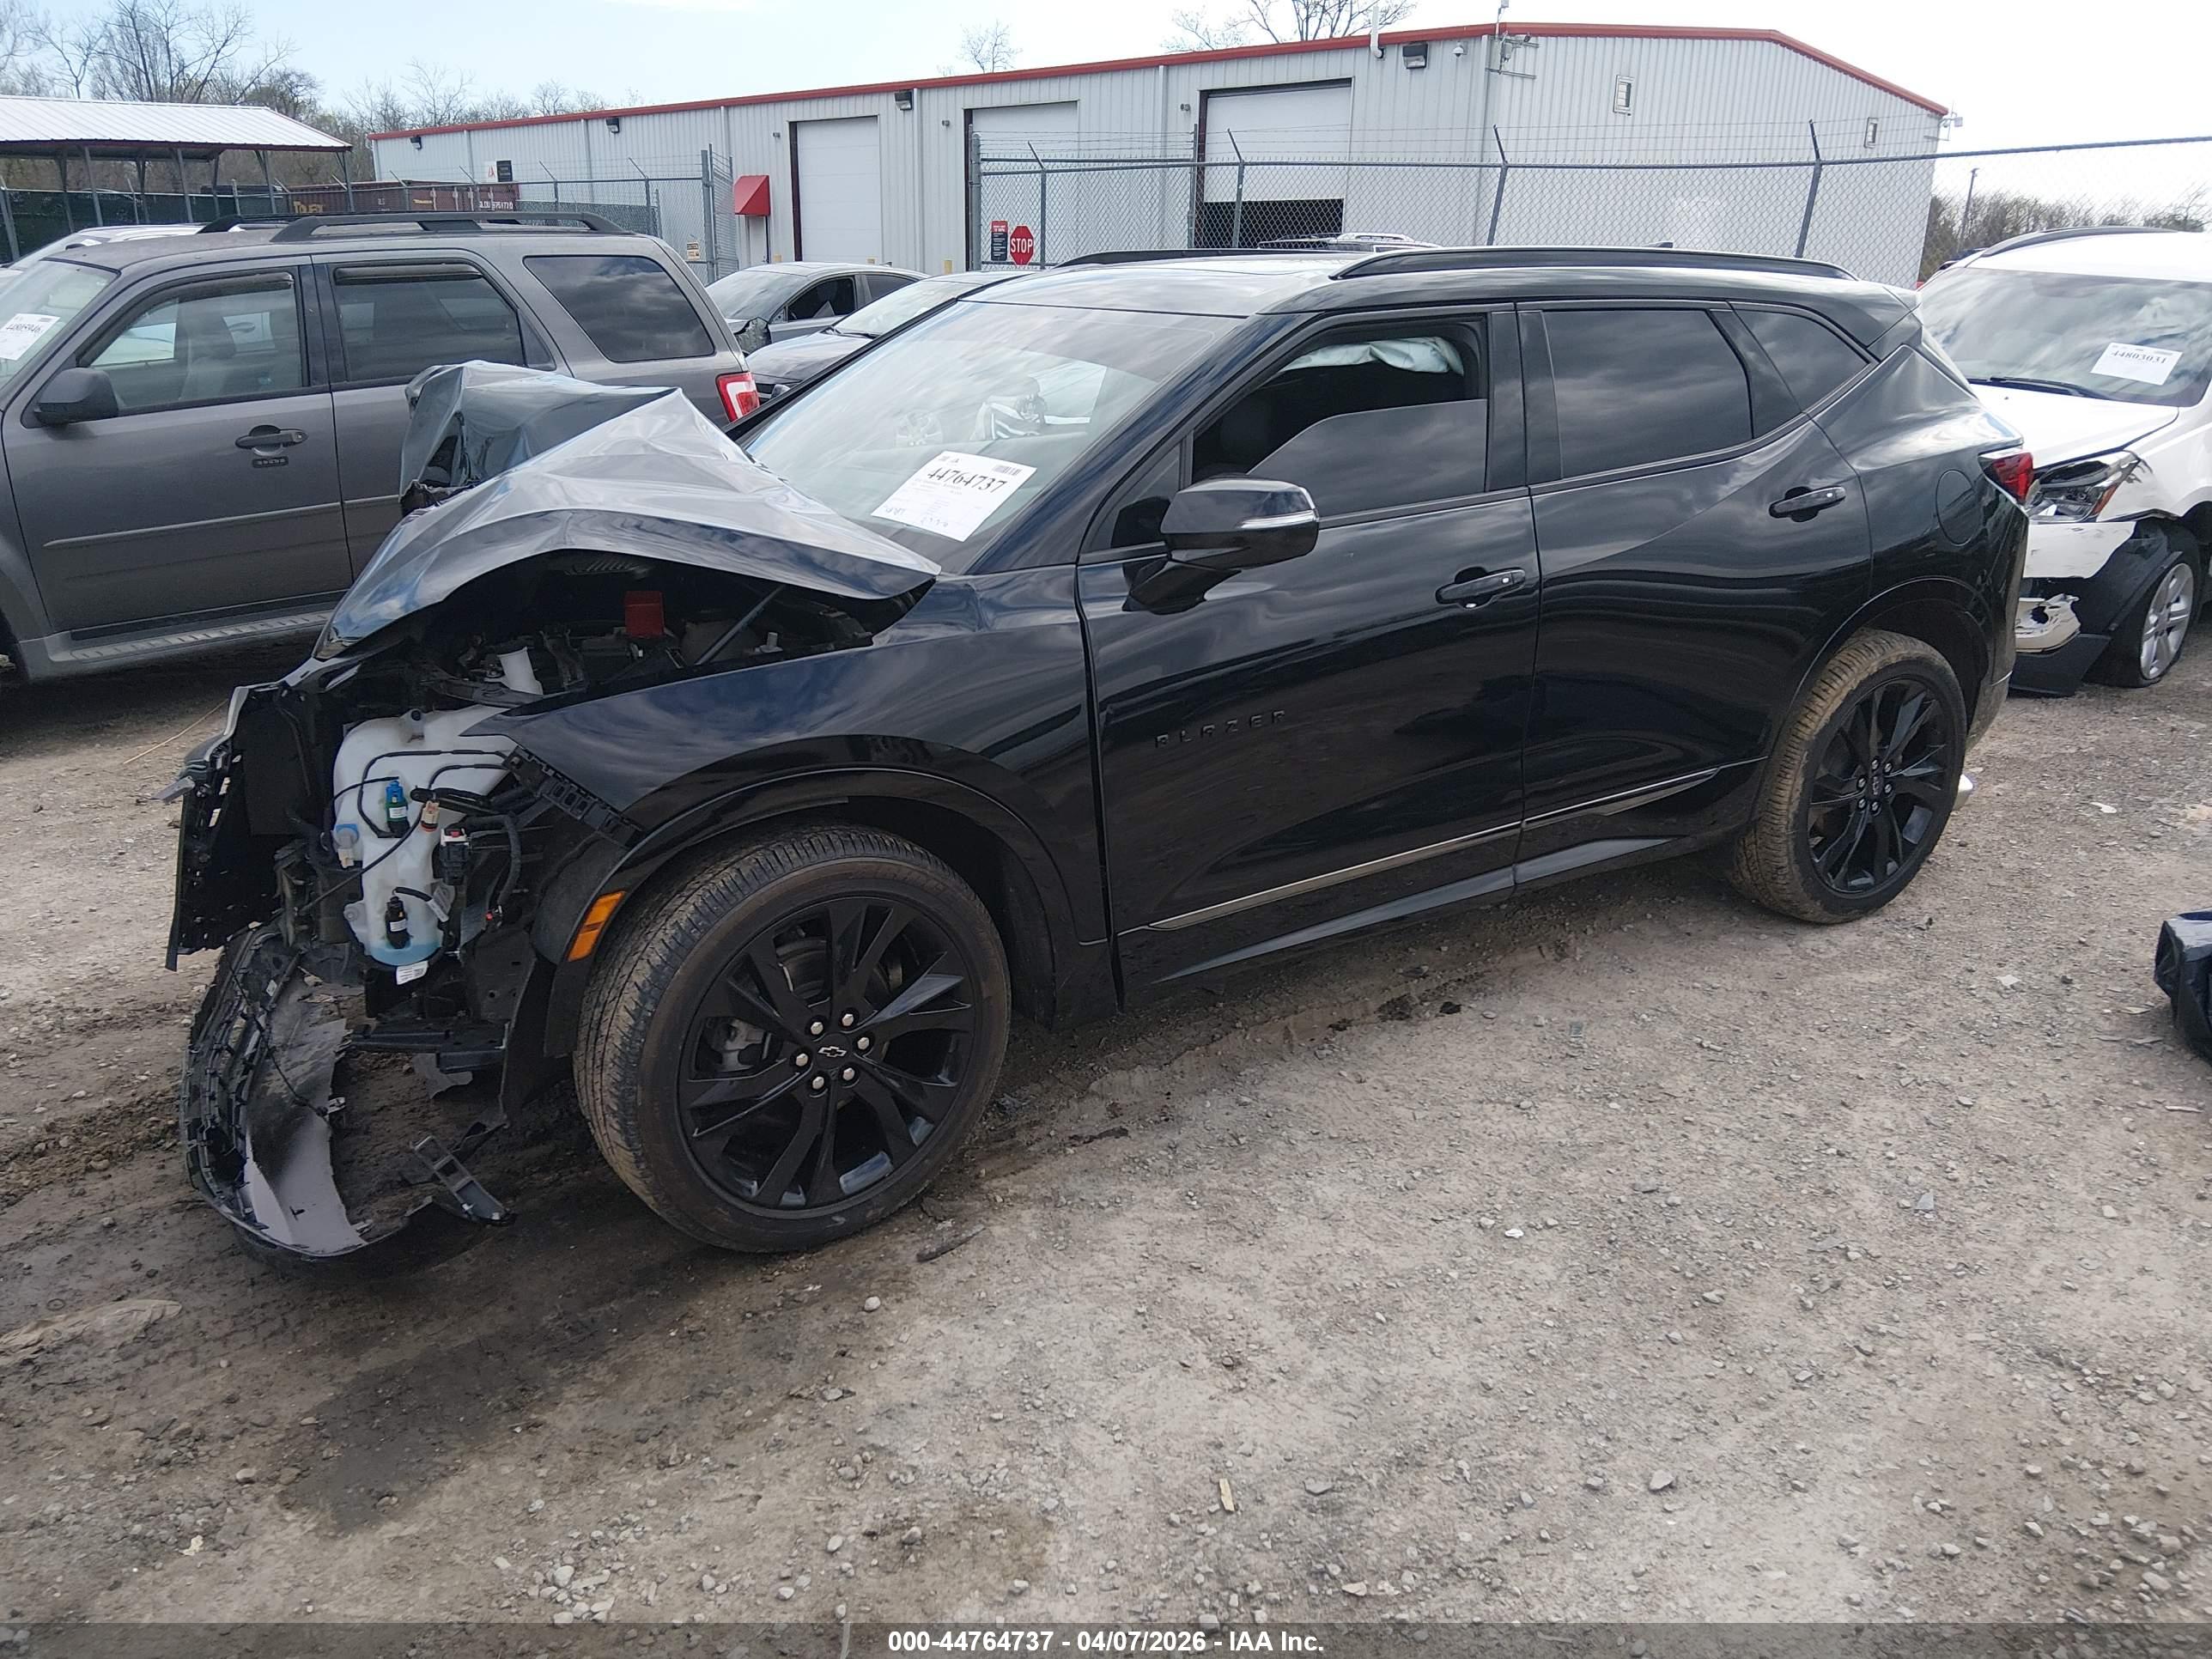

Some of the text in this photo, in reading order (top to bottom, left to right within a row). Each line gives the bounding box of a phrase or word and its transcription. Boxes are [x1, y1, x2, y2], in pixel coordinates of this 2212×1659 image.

[1011, 238, 1033, 253] STOP
[2112, 350, 2167, 364] 44803031
[927, 467, 1008, 493] 44764737
[1155, 709, 1285, 748] BLAZER
